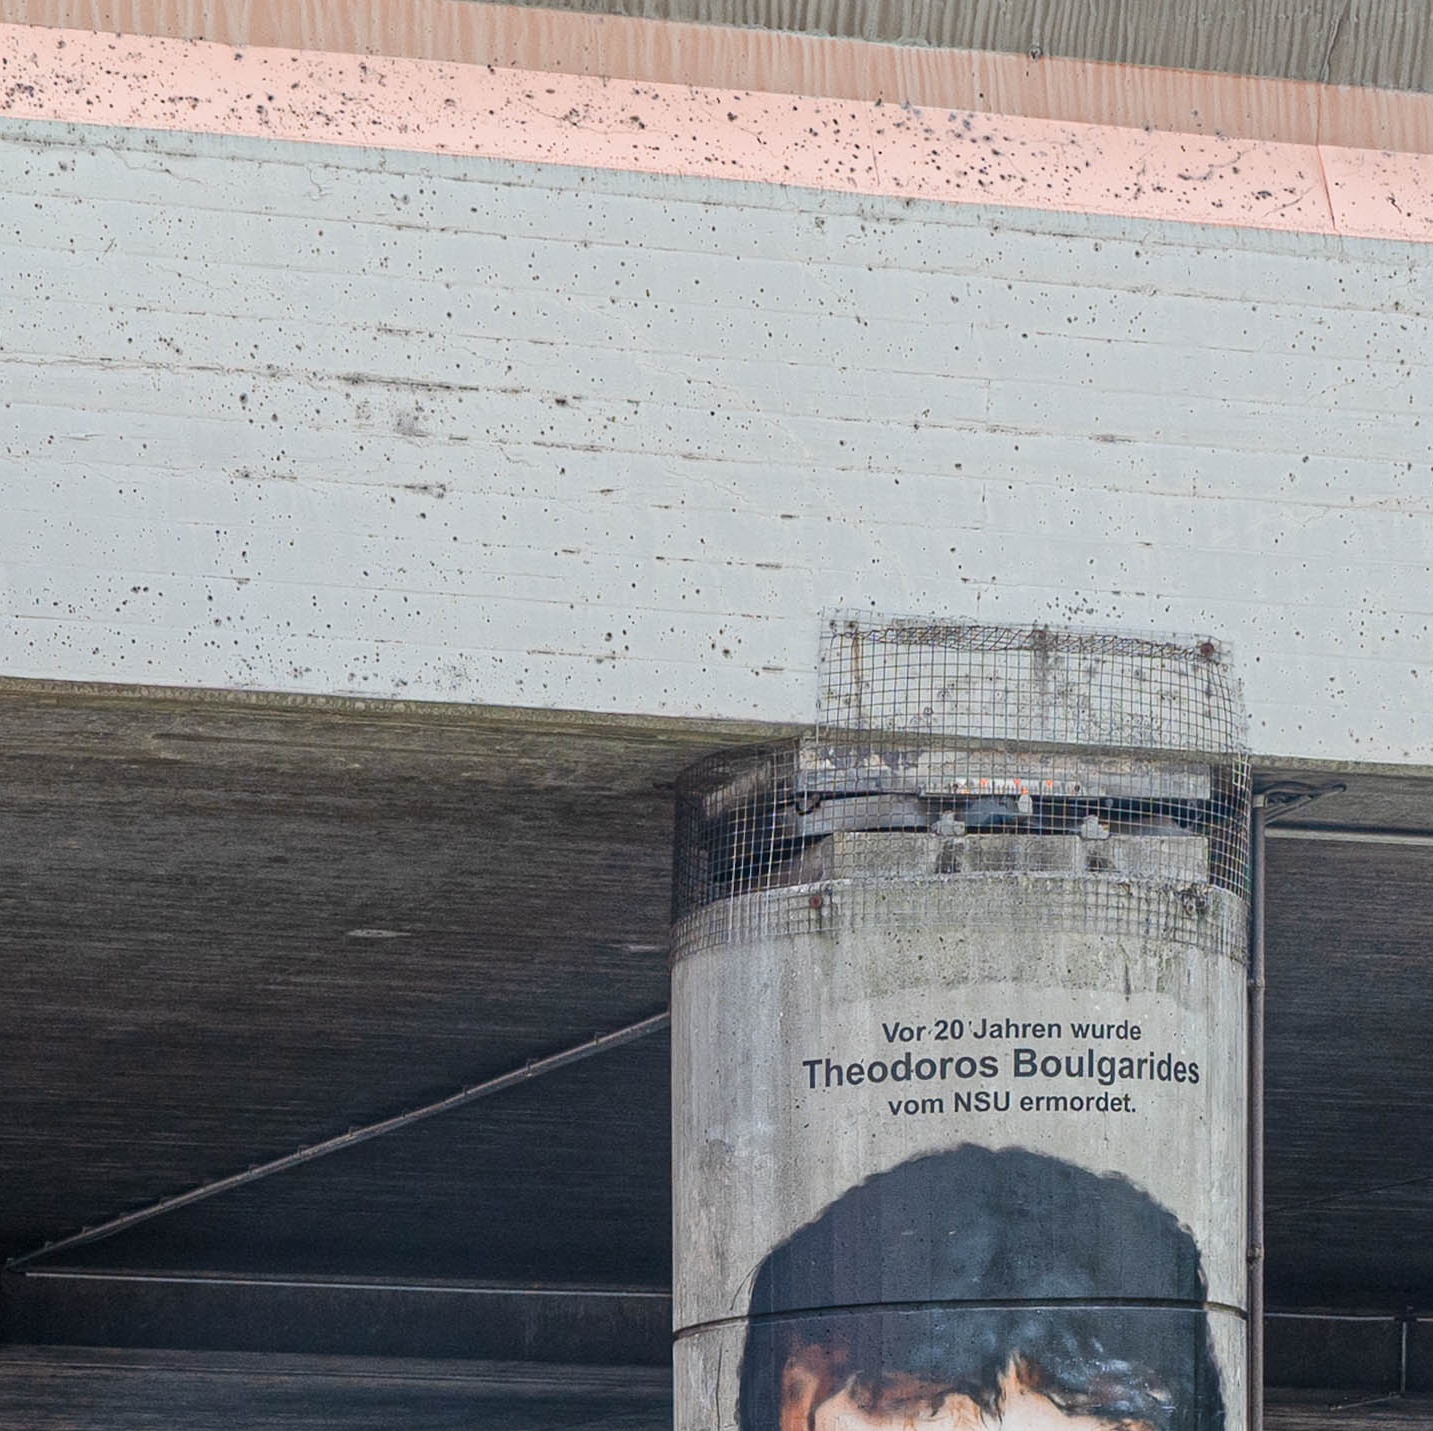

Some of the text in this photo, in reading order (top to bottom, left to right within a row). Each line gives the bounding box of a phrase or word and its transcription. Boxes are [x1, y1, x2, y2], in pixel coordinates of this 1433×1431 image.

[882, 1017, 1142, 1043] Vor 20 Jahren wurde
[802, 1048, 1200, 1090] Theodoros Boulgarides
[888, 1091, 1137, 1117] vom NSU ermordet.
